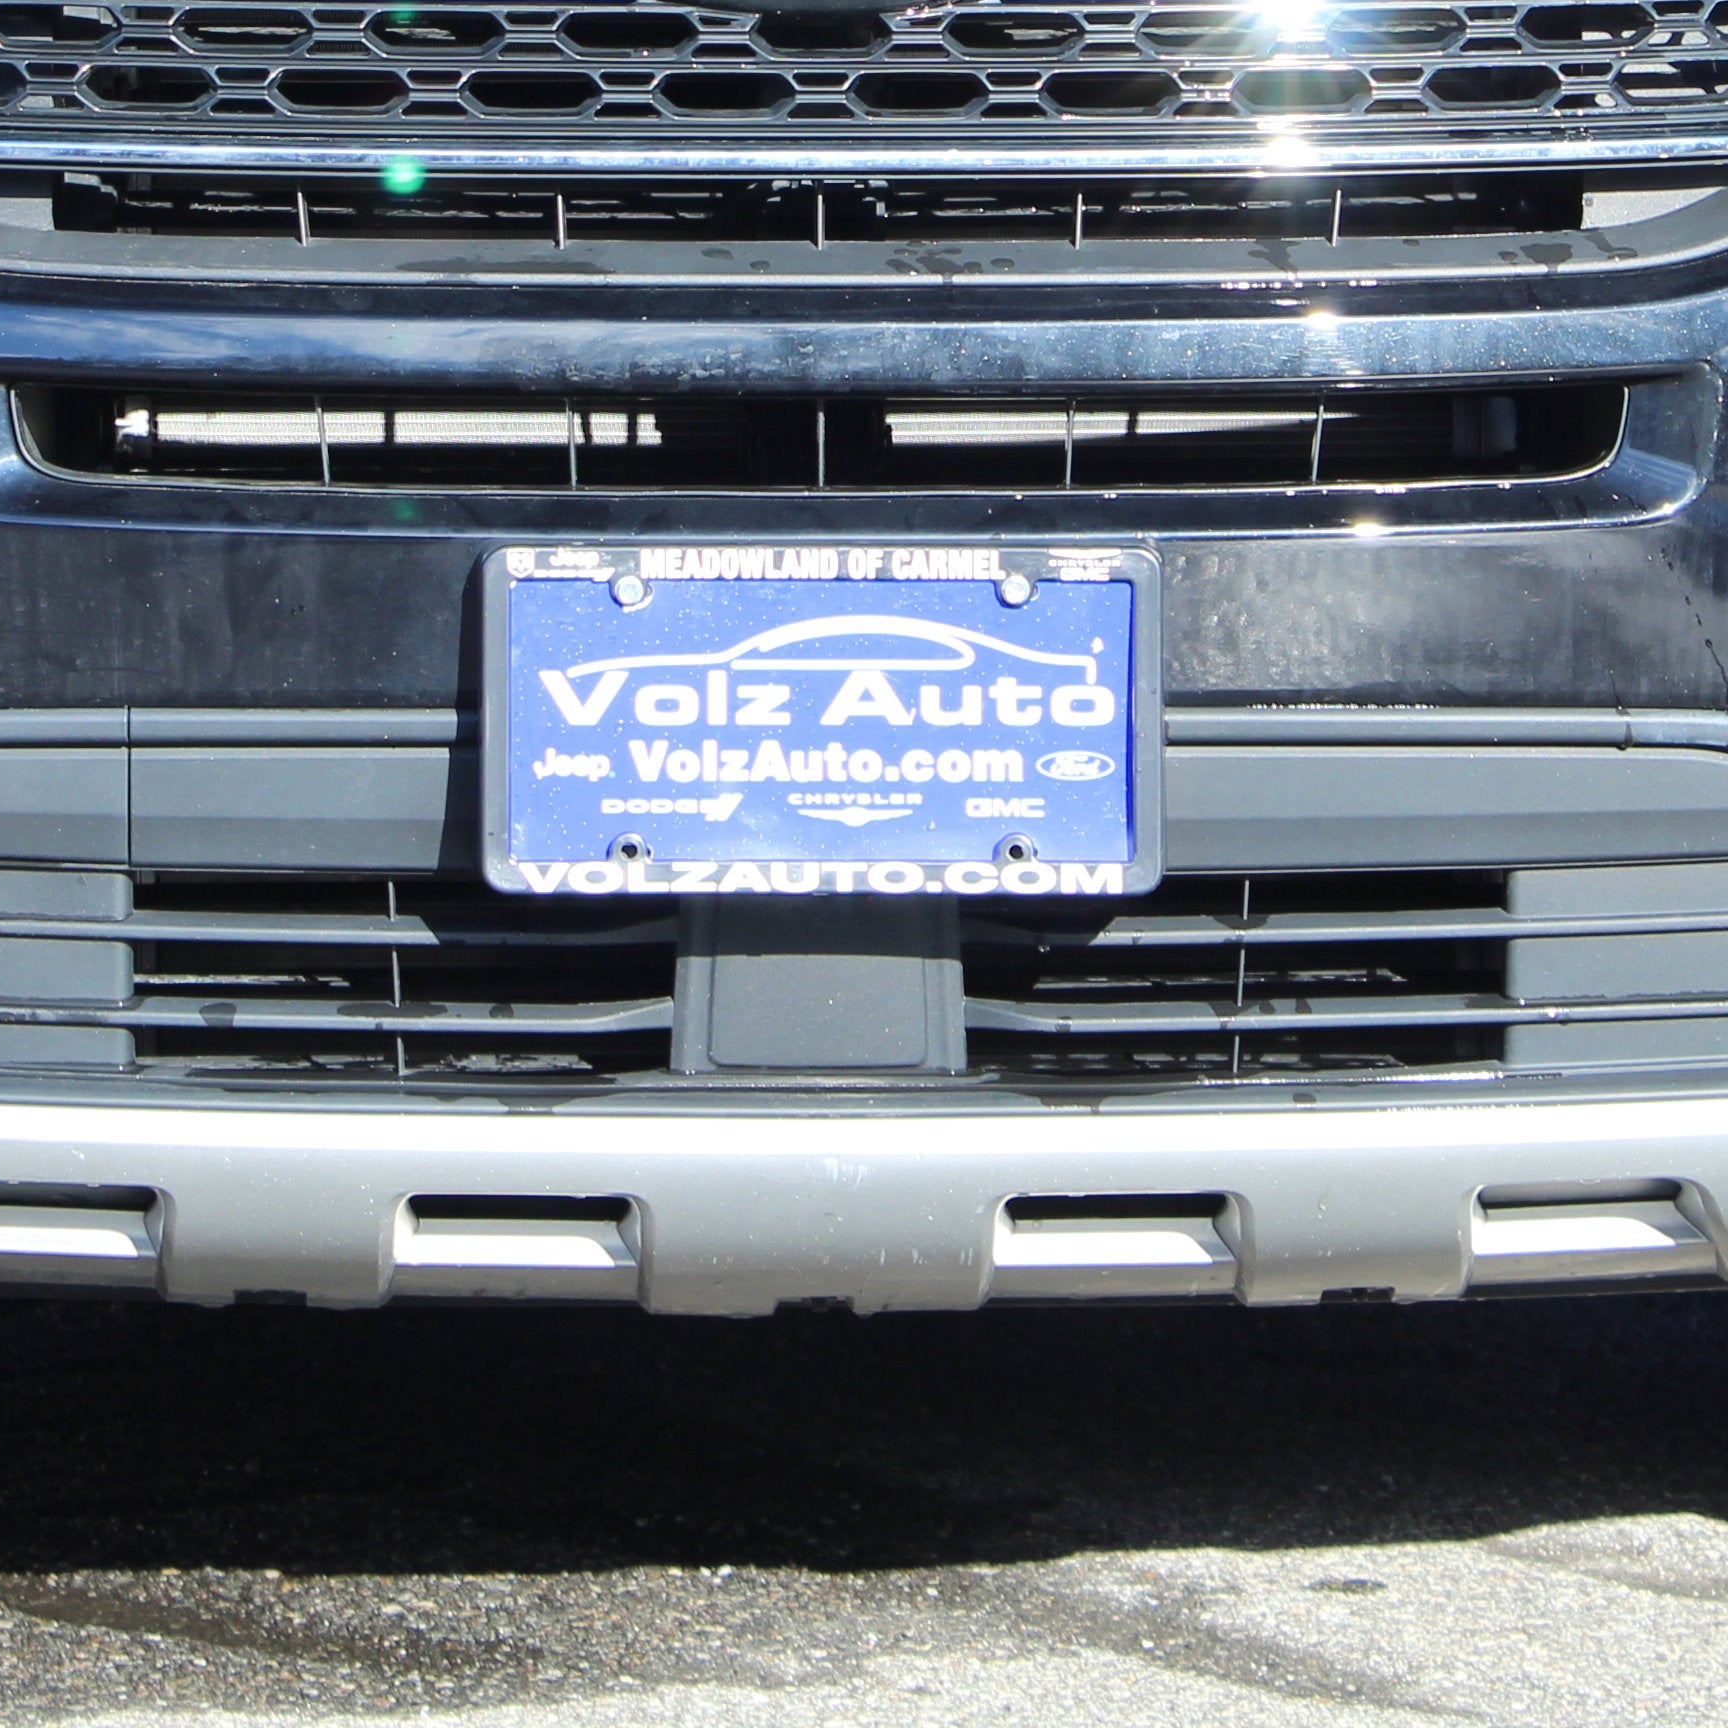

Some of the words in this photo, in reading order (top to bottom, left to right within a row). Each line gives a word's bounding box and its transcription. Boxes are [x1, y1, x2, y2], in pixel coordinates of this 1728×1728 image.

[640, 548, 839, 580] MEADOWLAND
[847, 549, 885, 580] OF
[891, 549, 1007, 580] CARMEL
[539, 670, 791, 726] Volz
[820, 670, 1115, 726] Auto
[532, 747, 610, 782] Jeep
[628, 739, 1024, 783] VolzAuto.com
[787, 793, 923, 805] CHRYSLER
[965, 798, 1046, 818] GMC
[519, 861, 1126, 895] VOLZAUTO.COM
